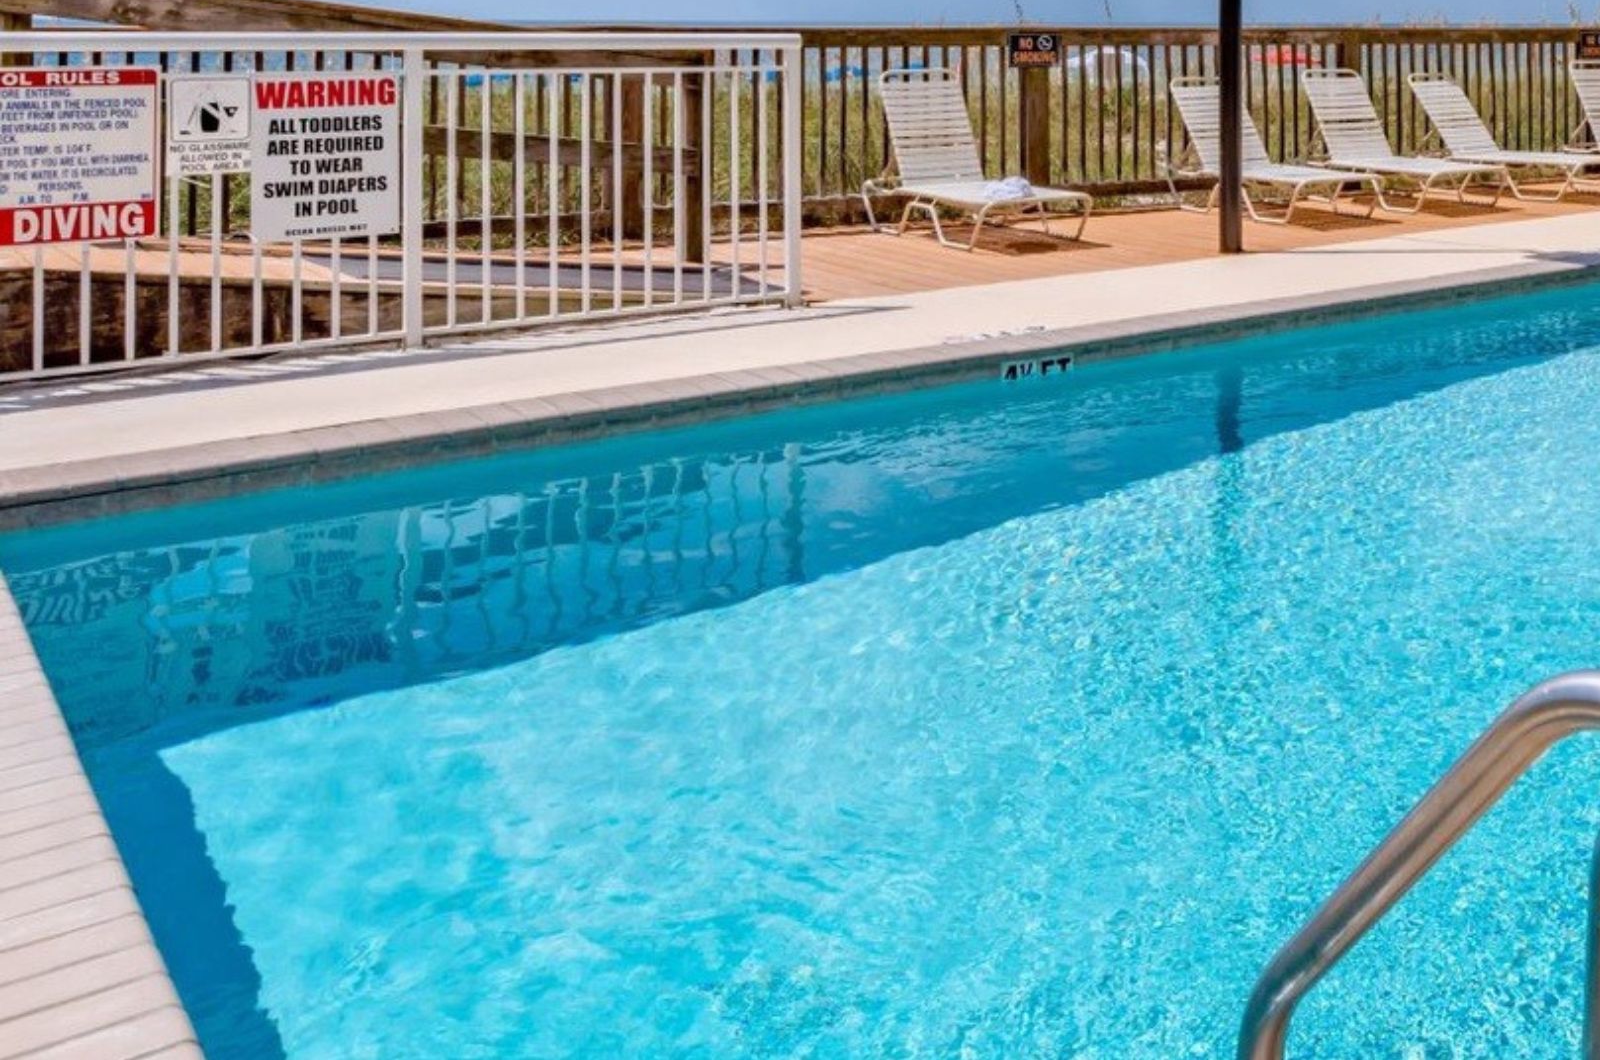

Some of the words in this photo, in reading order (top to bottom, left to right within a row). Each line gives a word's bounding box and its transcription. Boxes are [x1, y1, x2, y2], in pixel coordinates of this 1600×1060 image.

[45, 71, 120, 84] RULES
[255, 78, 396, 109] WARNING
[6, 100, 48, 110] ANIMALS
[51, 100, 61, 109] IN
[64, 99, 81, 109] THE
[123, 98, 147, 107] POOL
[1, 111, 23, 121] FEET
[27, 110, 54, 120] FROM
[269, 118, 296, 135] ALL
[299, 115, 383, 133] TODDLERS
[1, 122, 56, 133] BEVERAGES
[60, 122, 69, 131] IN
[72, 121, 96, 131] POOL
[267, 140, 299, 156] ARE
[304, 136, 384, 154] REQUIRED
[290, 160, 311, 175] TO
[316, 158, 363, 174] WEAR
[264, 181, 314, 198] SWIM
[318, 176, 387, 195] DIAPERS
[294, 202, 312, 218] IN
[317, 199, 359, 215] POOL
[13, 203, 146, 243] DIVING
[1040, 357, 1071, 376] FT
